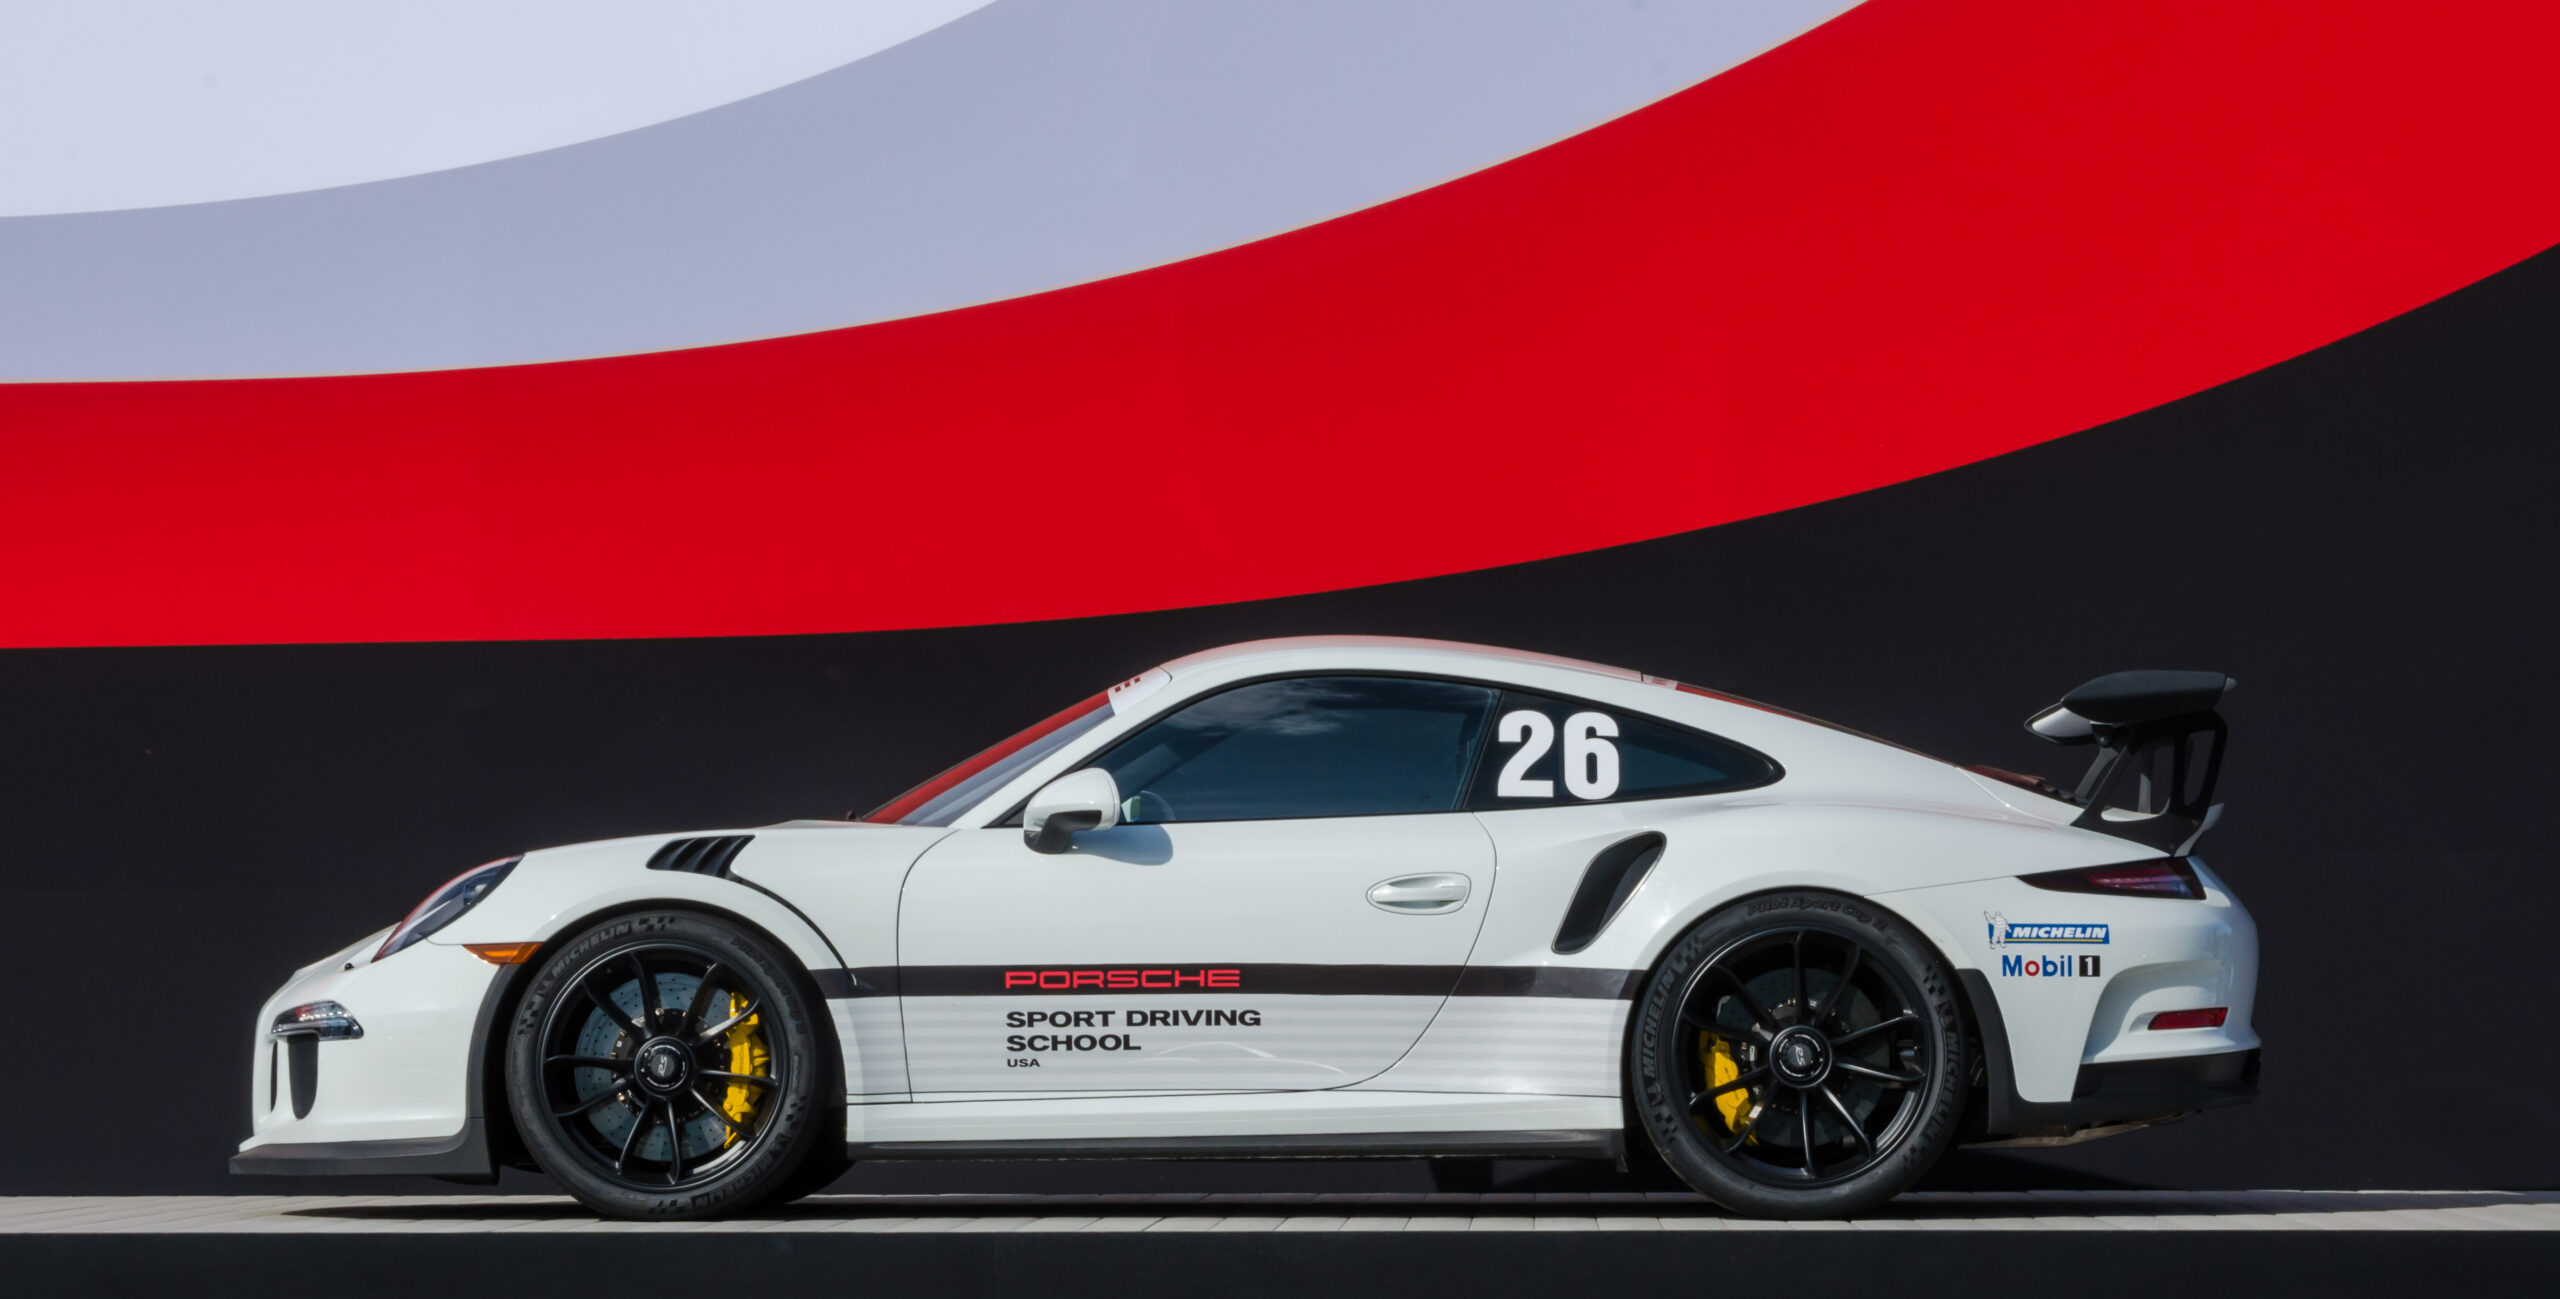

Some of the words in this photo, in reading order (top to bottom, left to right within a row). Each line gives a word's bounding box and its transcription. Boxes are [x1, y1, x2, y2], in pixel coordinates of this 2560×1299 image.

[1498, 709, 1620, 800] 26
[1791, 896, 1841, 911] Sport
[1843, 904, 1872, 924] Cup
[2012, 926, 2106, 938] MICHELIN
[549, 922, 630, 977] MICHELIN
[2002, 955, 2073, 977] Mobil
[1005, 969, 1241, 989] PORSCHE
[1006, 1010, 1115, 1028] SPORT
[1126, 1009, 1262, 1027] DRIVING
[1640, 967, 1674, 1078] MICHELIN
[1006, 1034, 1142, 1052] SCHOOL
[1006, 1058, 1041, 1068] USA
[1931, 1031, 1960, 1140] MICHELIN
